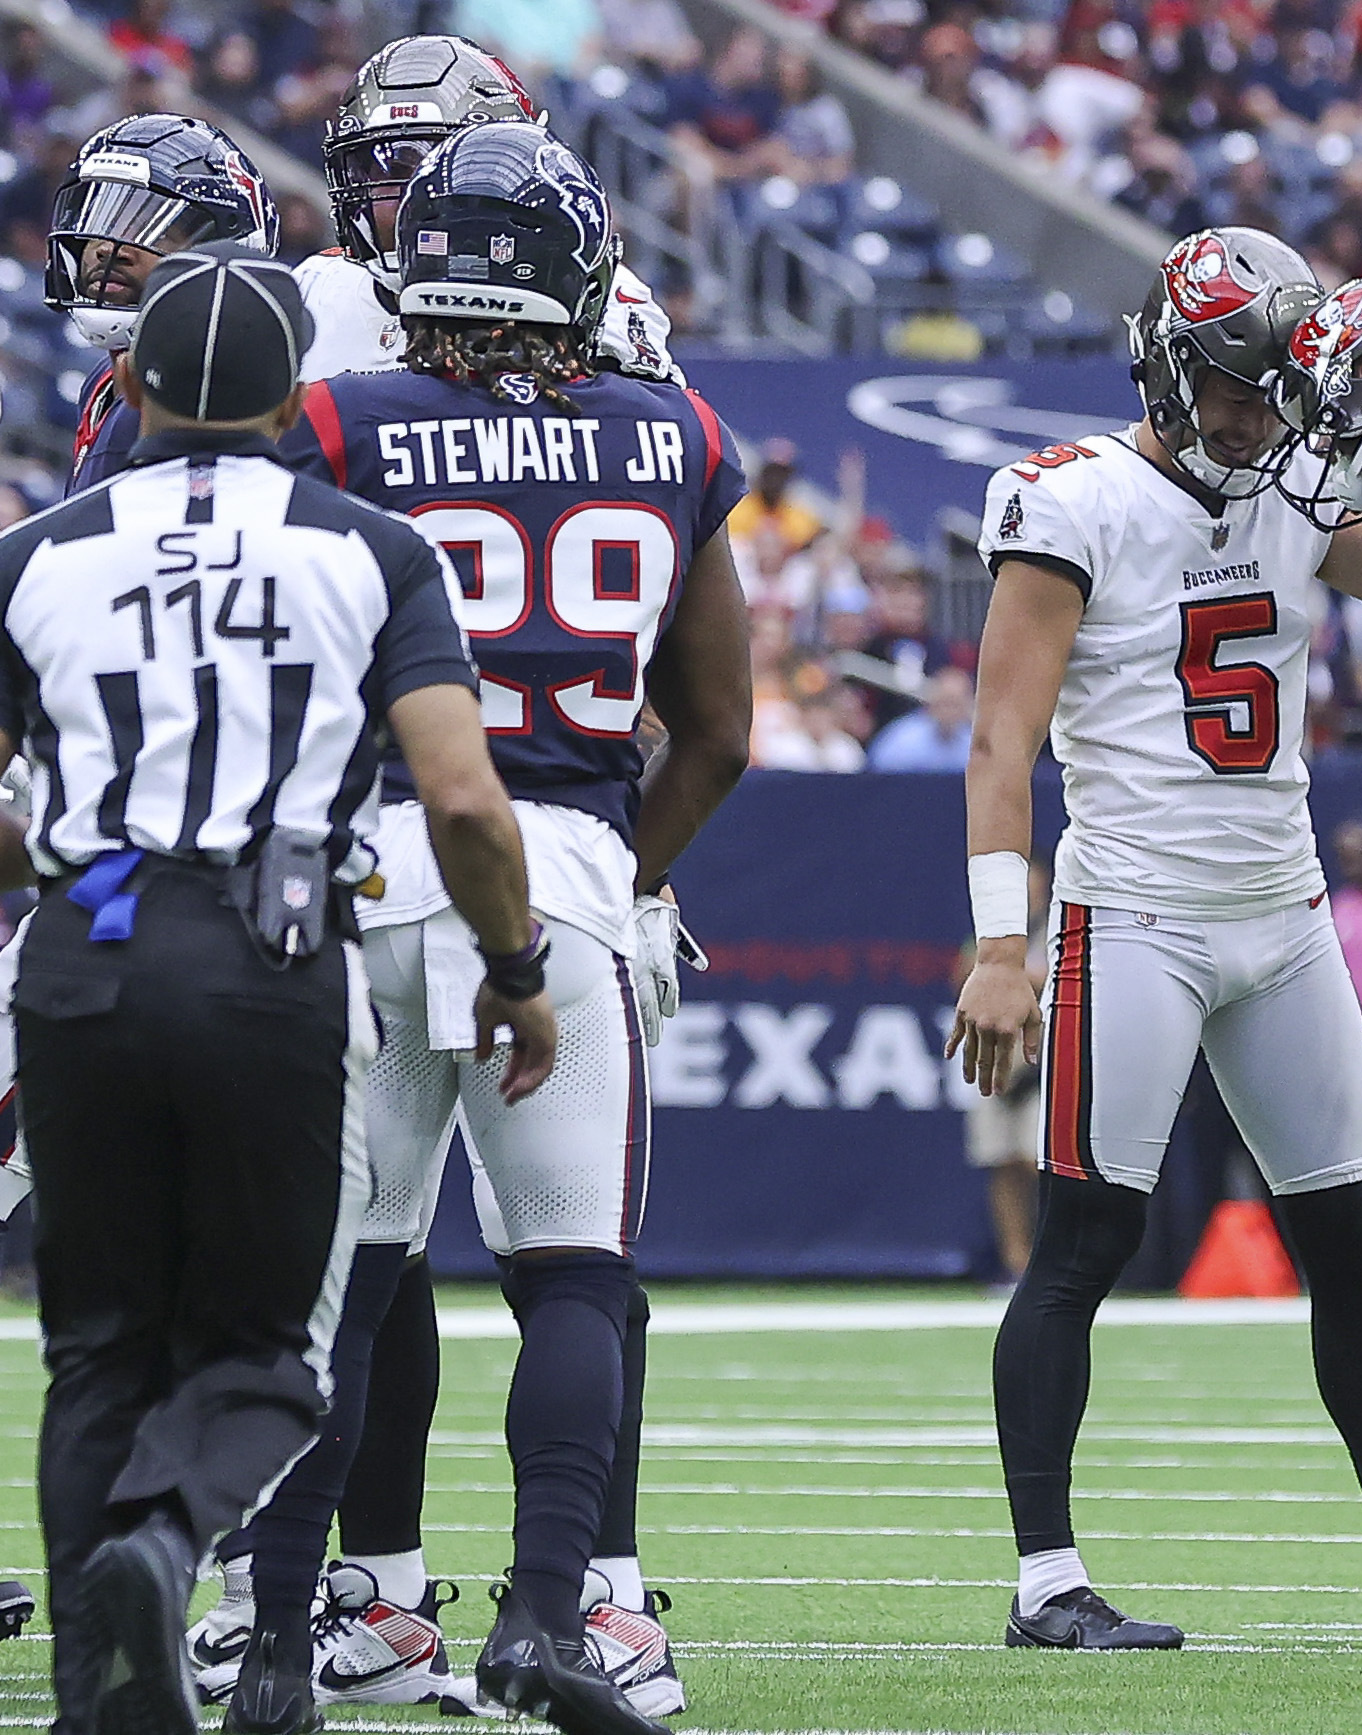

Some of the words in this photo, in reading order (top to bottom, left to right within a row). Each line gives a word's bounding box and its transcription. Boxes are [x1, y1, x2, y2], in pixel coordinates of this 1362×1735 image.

[93, 158, 139, 167] TEXANS
[418, 294, 525, 312] TEXANS
[377, 416, 600, 487] STEWART
[625, 420, 684, 485] JR
[156, 529, 243, 575] SJ
[112, 575, 290, 661] 114
[1175, 591, 1279, 775] 5
[650, 1000, 978, 1110] EXA
